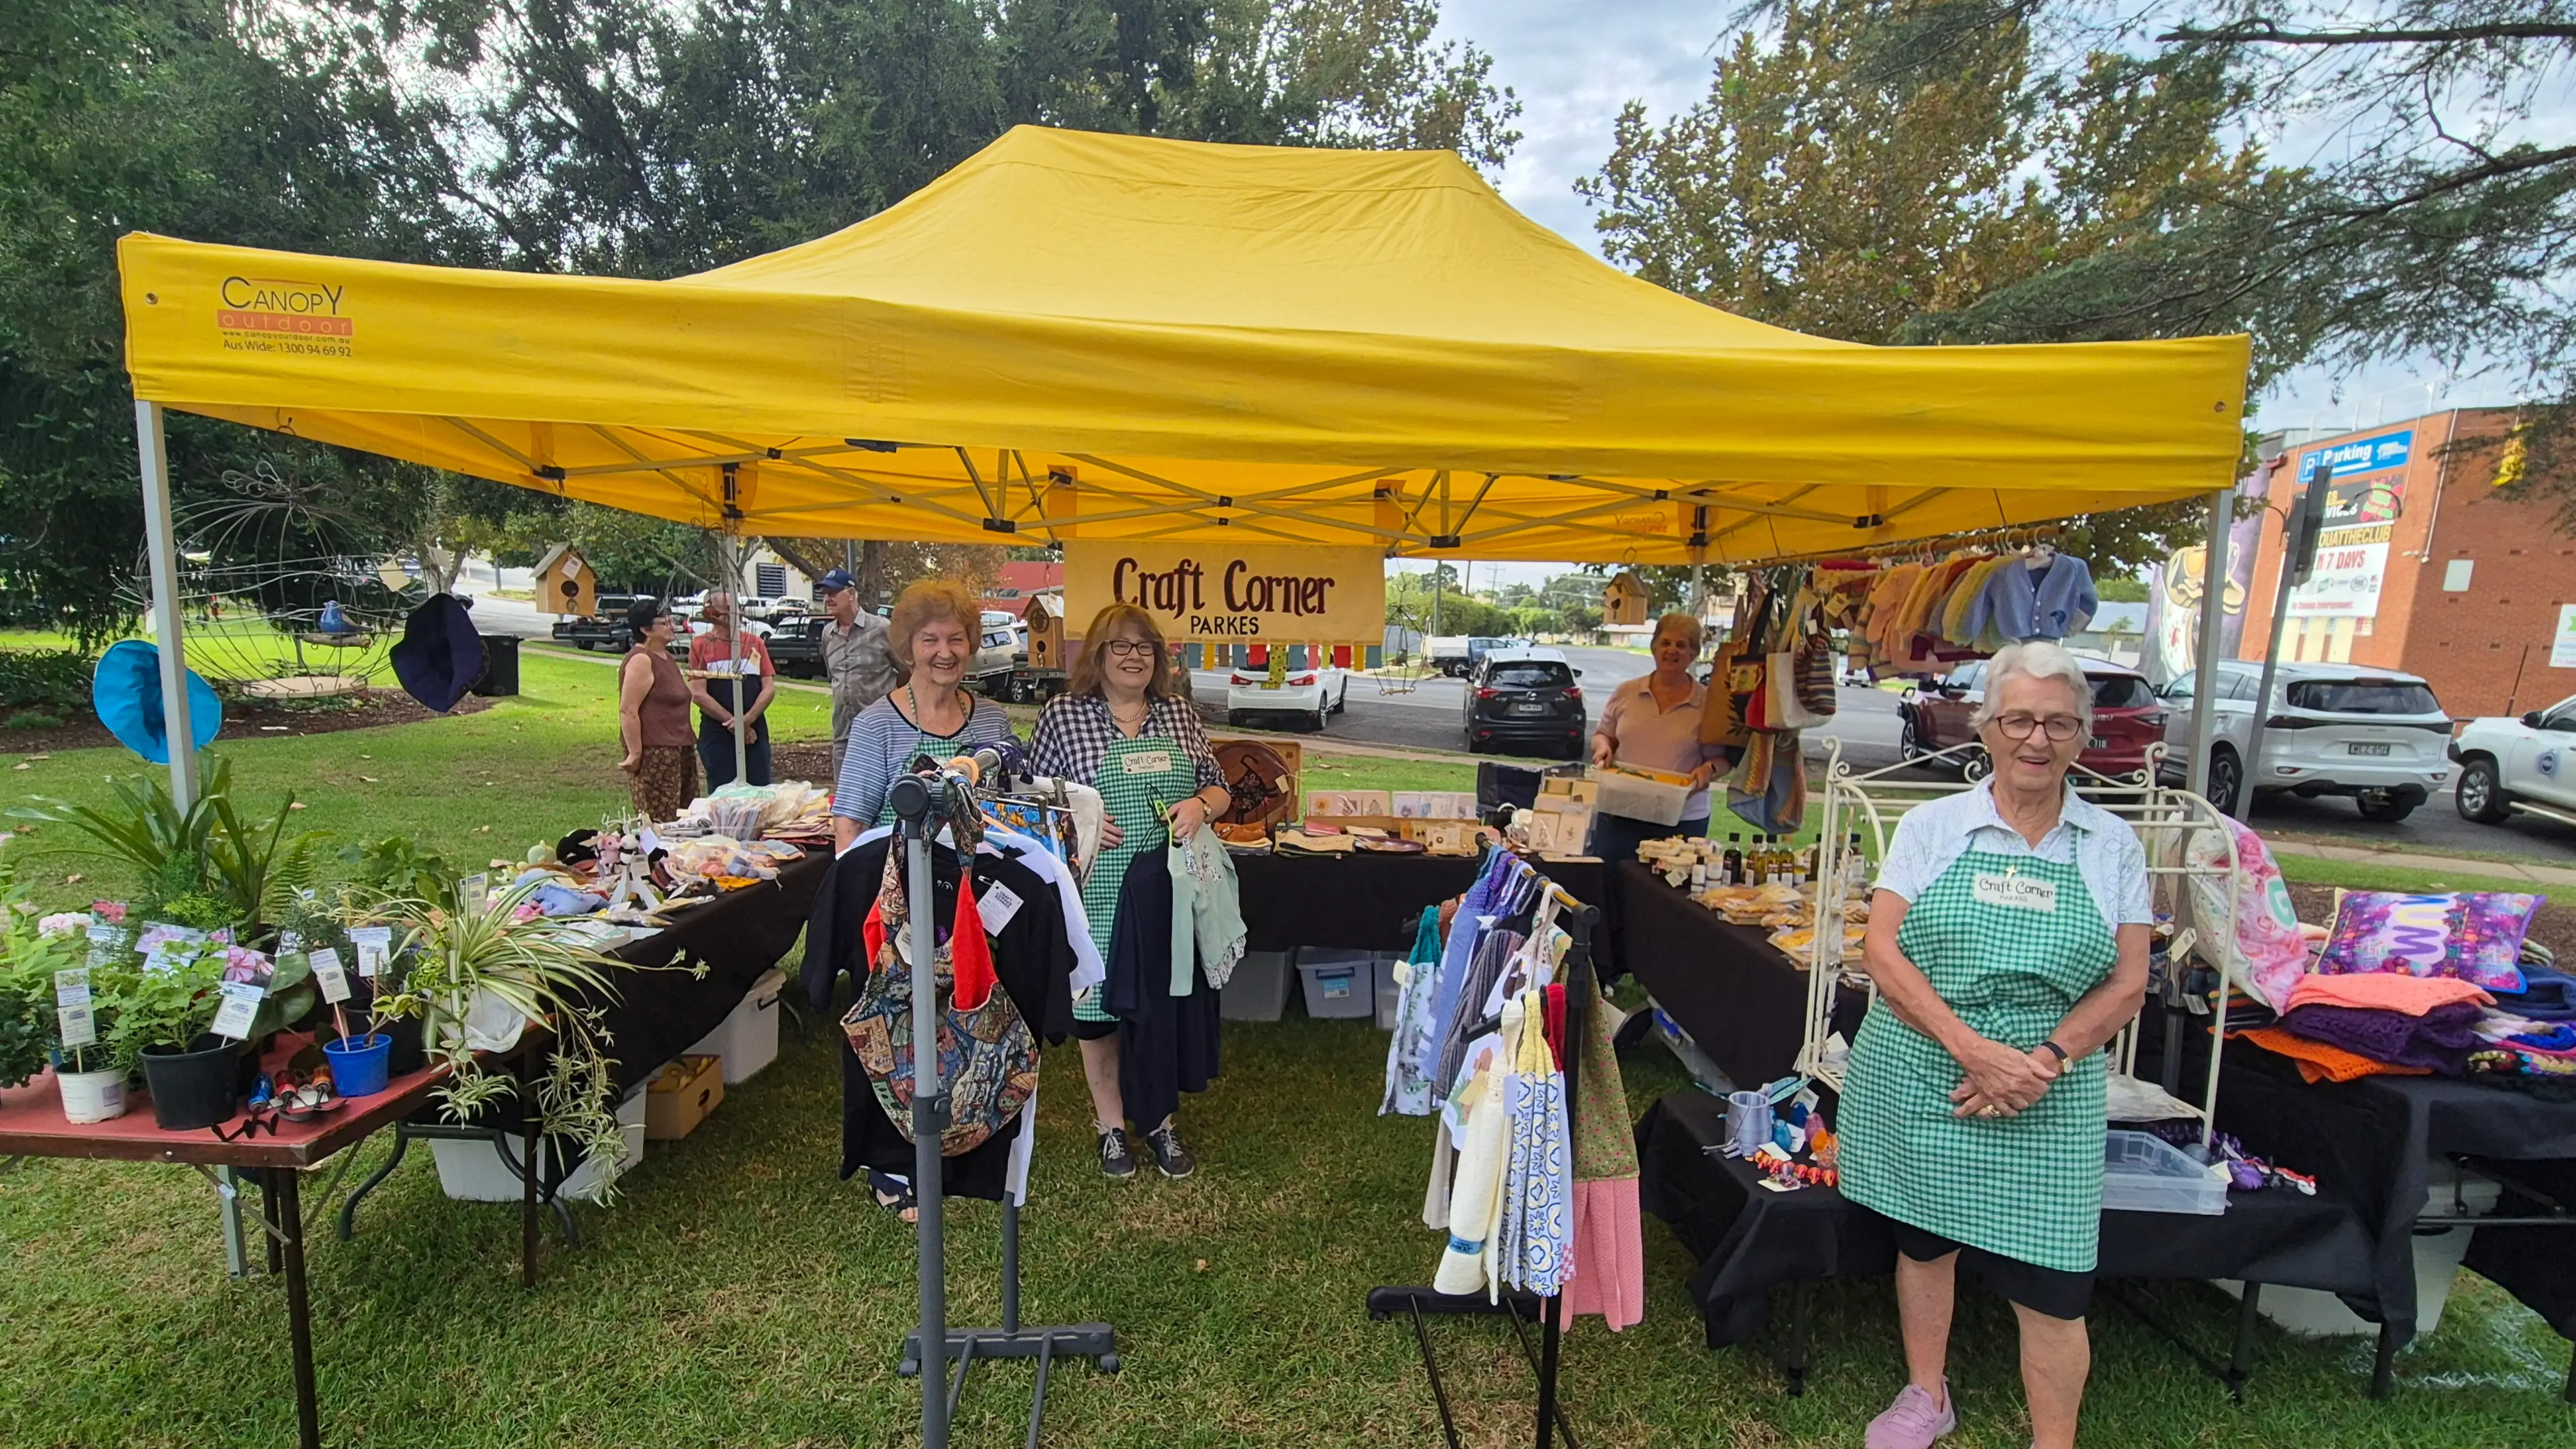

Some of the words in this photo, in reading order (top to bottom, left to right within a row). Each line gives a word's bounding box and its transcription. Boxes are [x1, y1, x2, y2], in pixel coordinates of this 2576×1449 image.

[222, 314, 347, 334] outdoor
[223, 339, 243, 350] Aus
[246, 341, 276, 352] Wide:
[279, 343, 305, 354] 1300
[307, 345, 320, 355] 94
[323, 345, 335, 356] 69
[338, 347, 352, 357] 92
[2336, 549, 2366, 570] DAYS
[1113, 557, 1205, 619] Craft
[1224, 559, 1335, 616] Corner
[1191, 615, 1259, 635] PARKES
[1125, 756, 1144, 767] Craft
[1979, 877, 2011, 894] Craft
[2015, 880, 2053, 899] Corner
